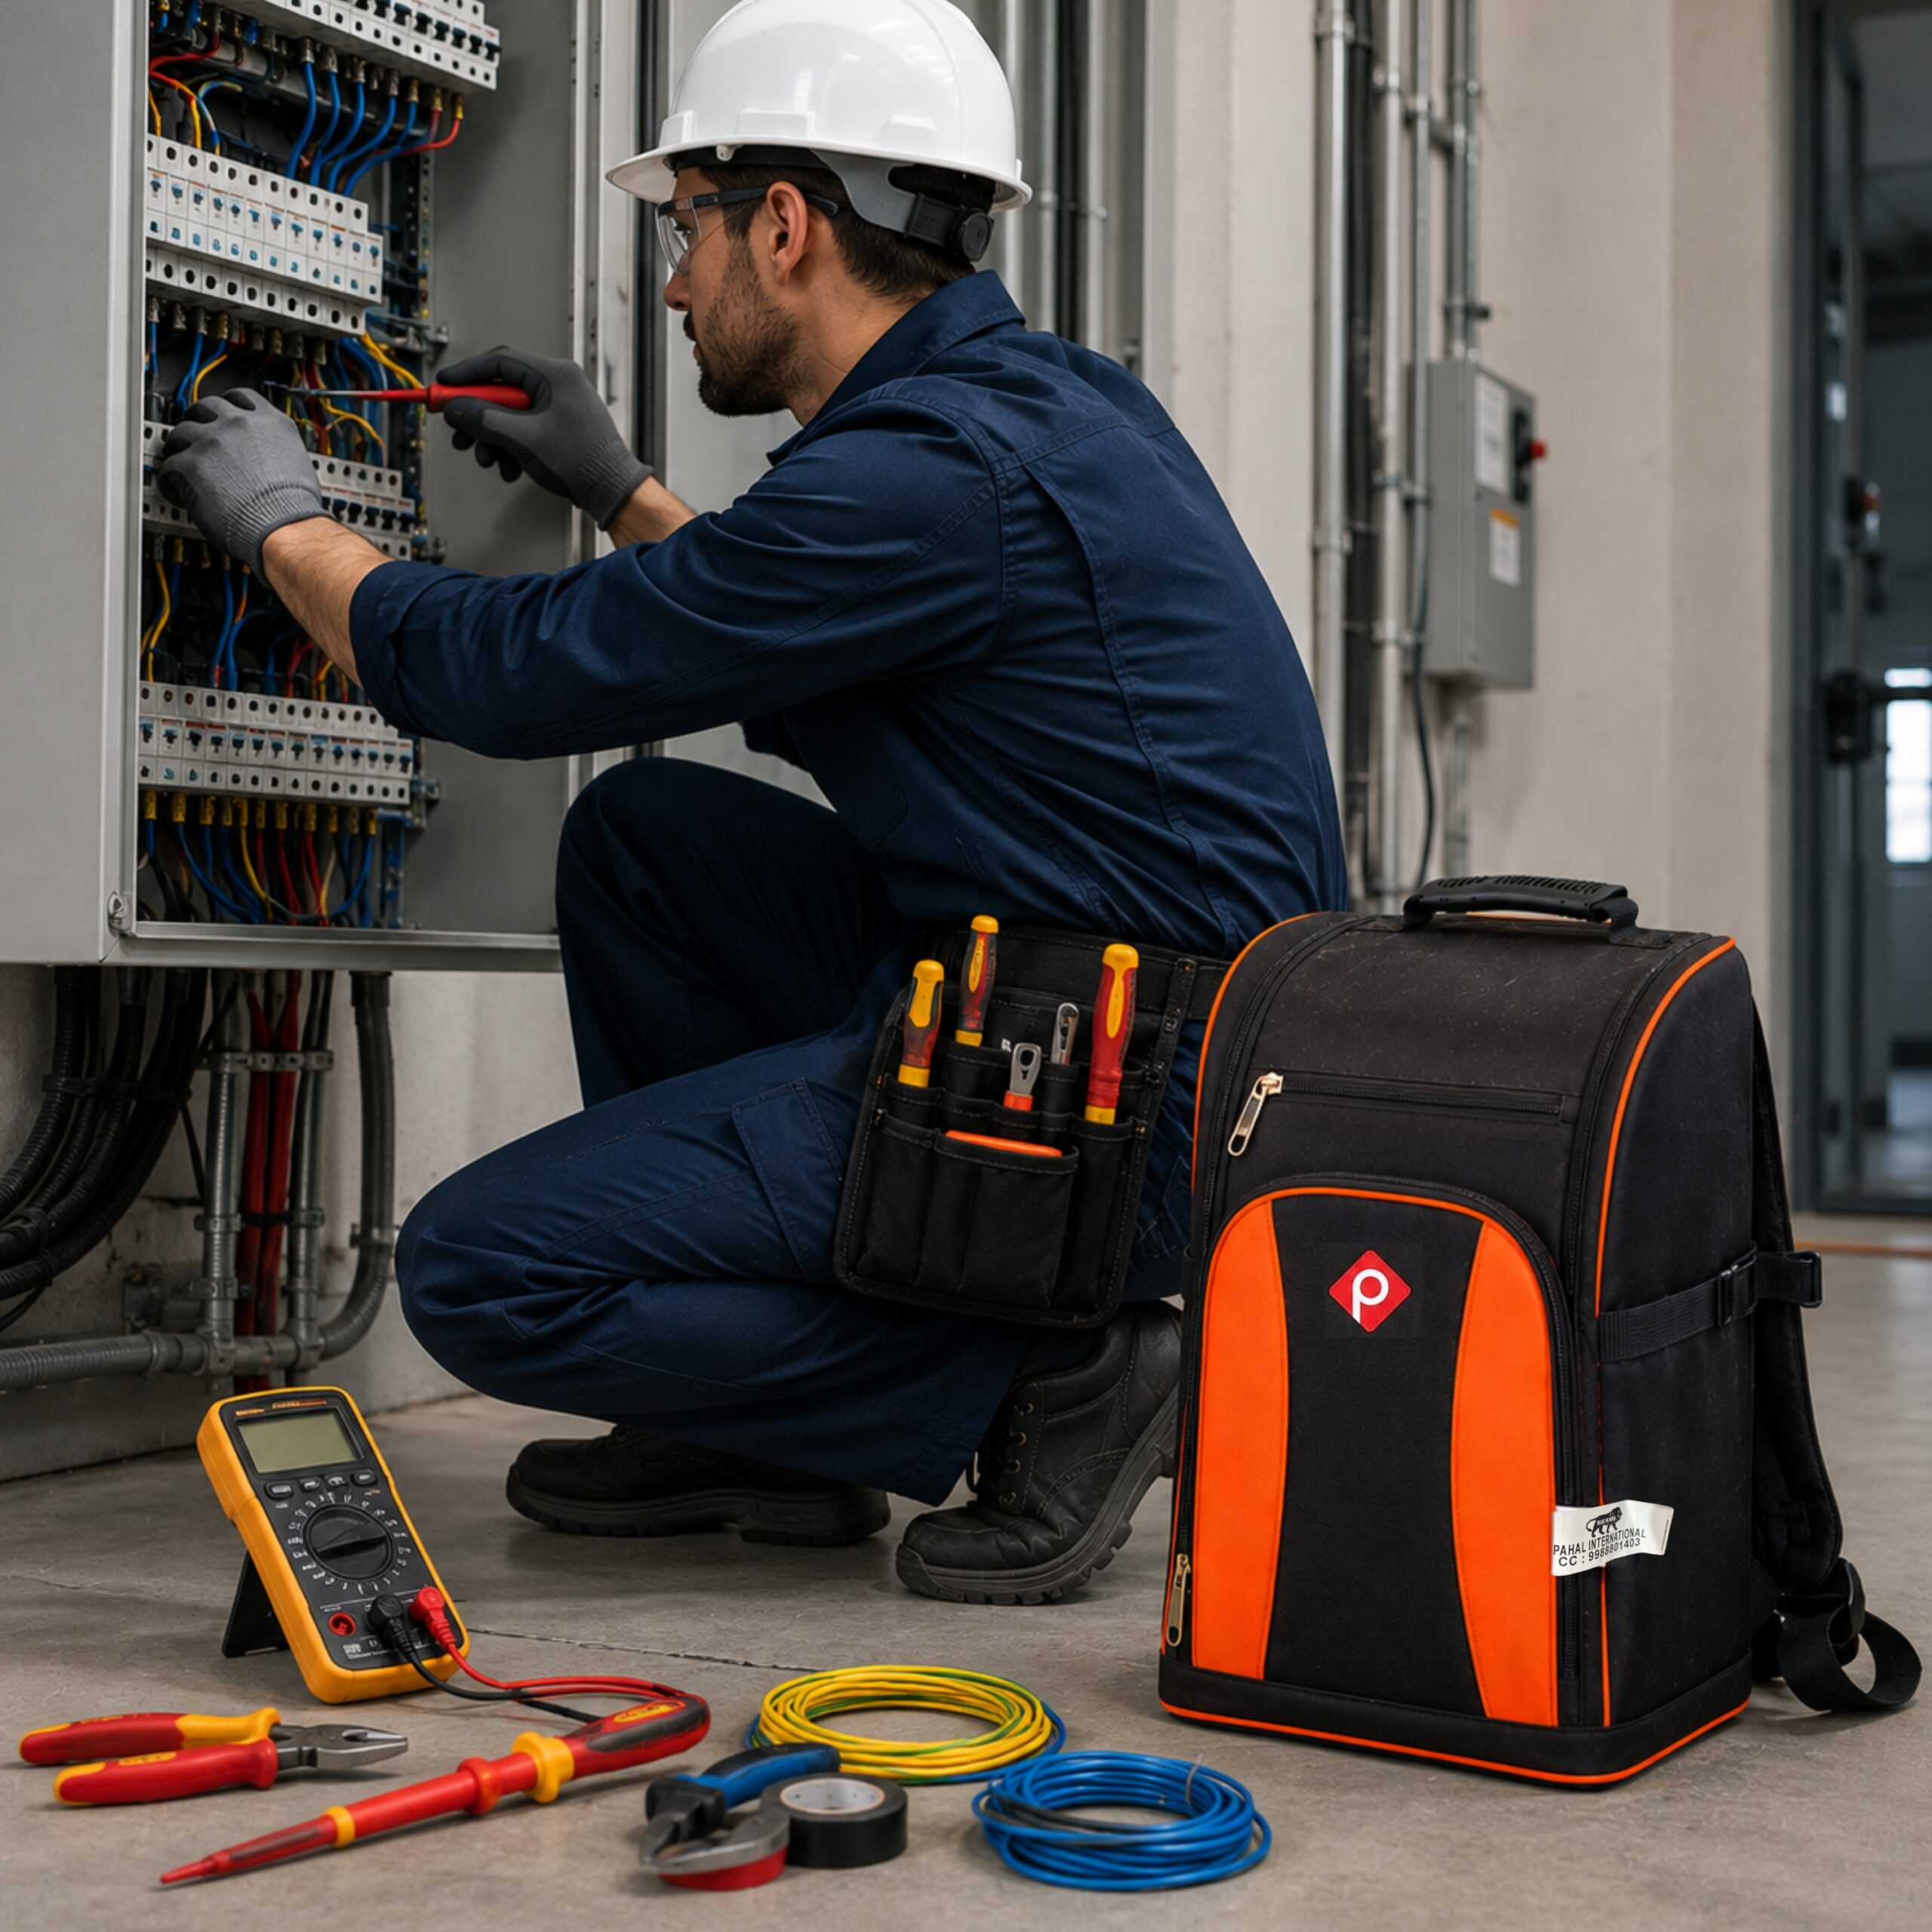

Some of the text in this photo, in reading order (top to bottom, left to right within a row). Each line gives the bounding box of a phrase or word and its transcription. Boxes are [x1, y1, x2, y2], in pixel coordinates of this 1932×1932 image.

[1553, 1527, 1646, 1555] PAHAL INTERNATIONAL
[1558, 1555, 1577, 1567] CC
[1589, 1537, 1641, 1561] 9988801403
